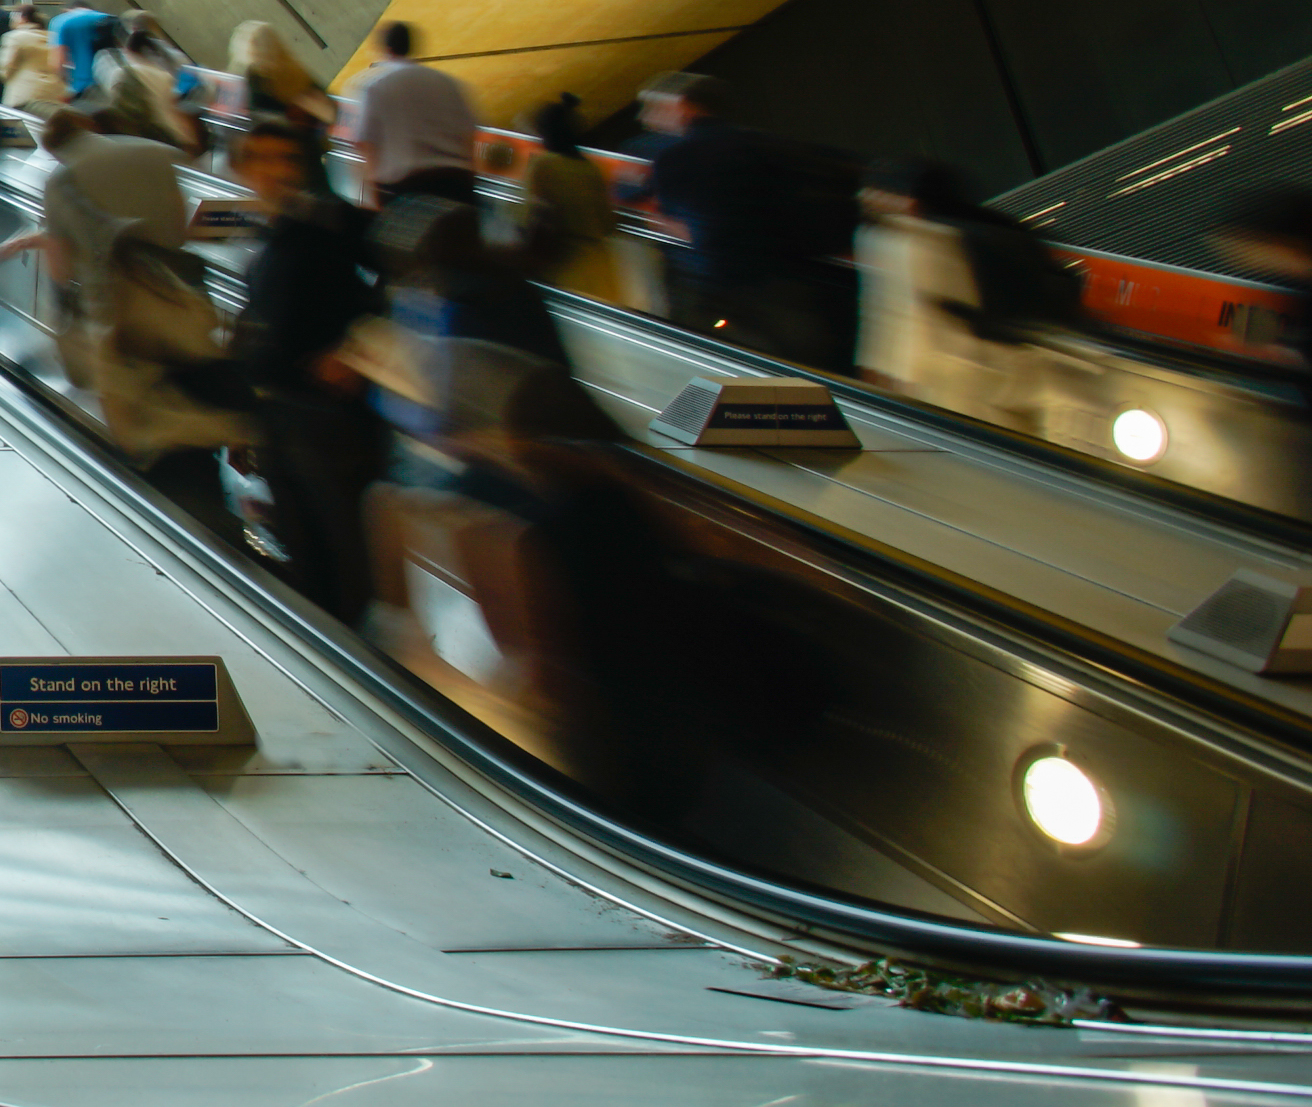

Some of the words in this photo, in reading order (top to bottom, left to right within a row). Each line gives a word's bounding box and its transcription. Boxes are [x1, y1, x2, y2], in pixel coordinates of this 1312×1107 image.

[724, 411, 750, 419] Please
[754, 412, 776, 420] stand
[791, 413, 805, 421] the
[808, 413, 826, 422] right
[30, 677, 75, 692] Stand
[81, 681, 101, 691] on
[106, 678, 134, 691] the
[140, 678, 177, 695] right
[30, 713, 48, 724] No
[53, 713, 102, 726] smoking
